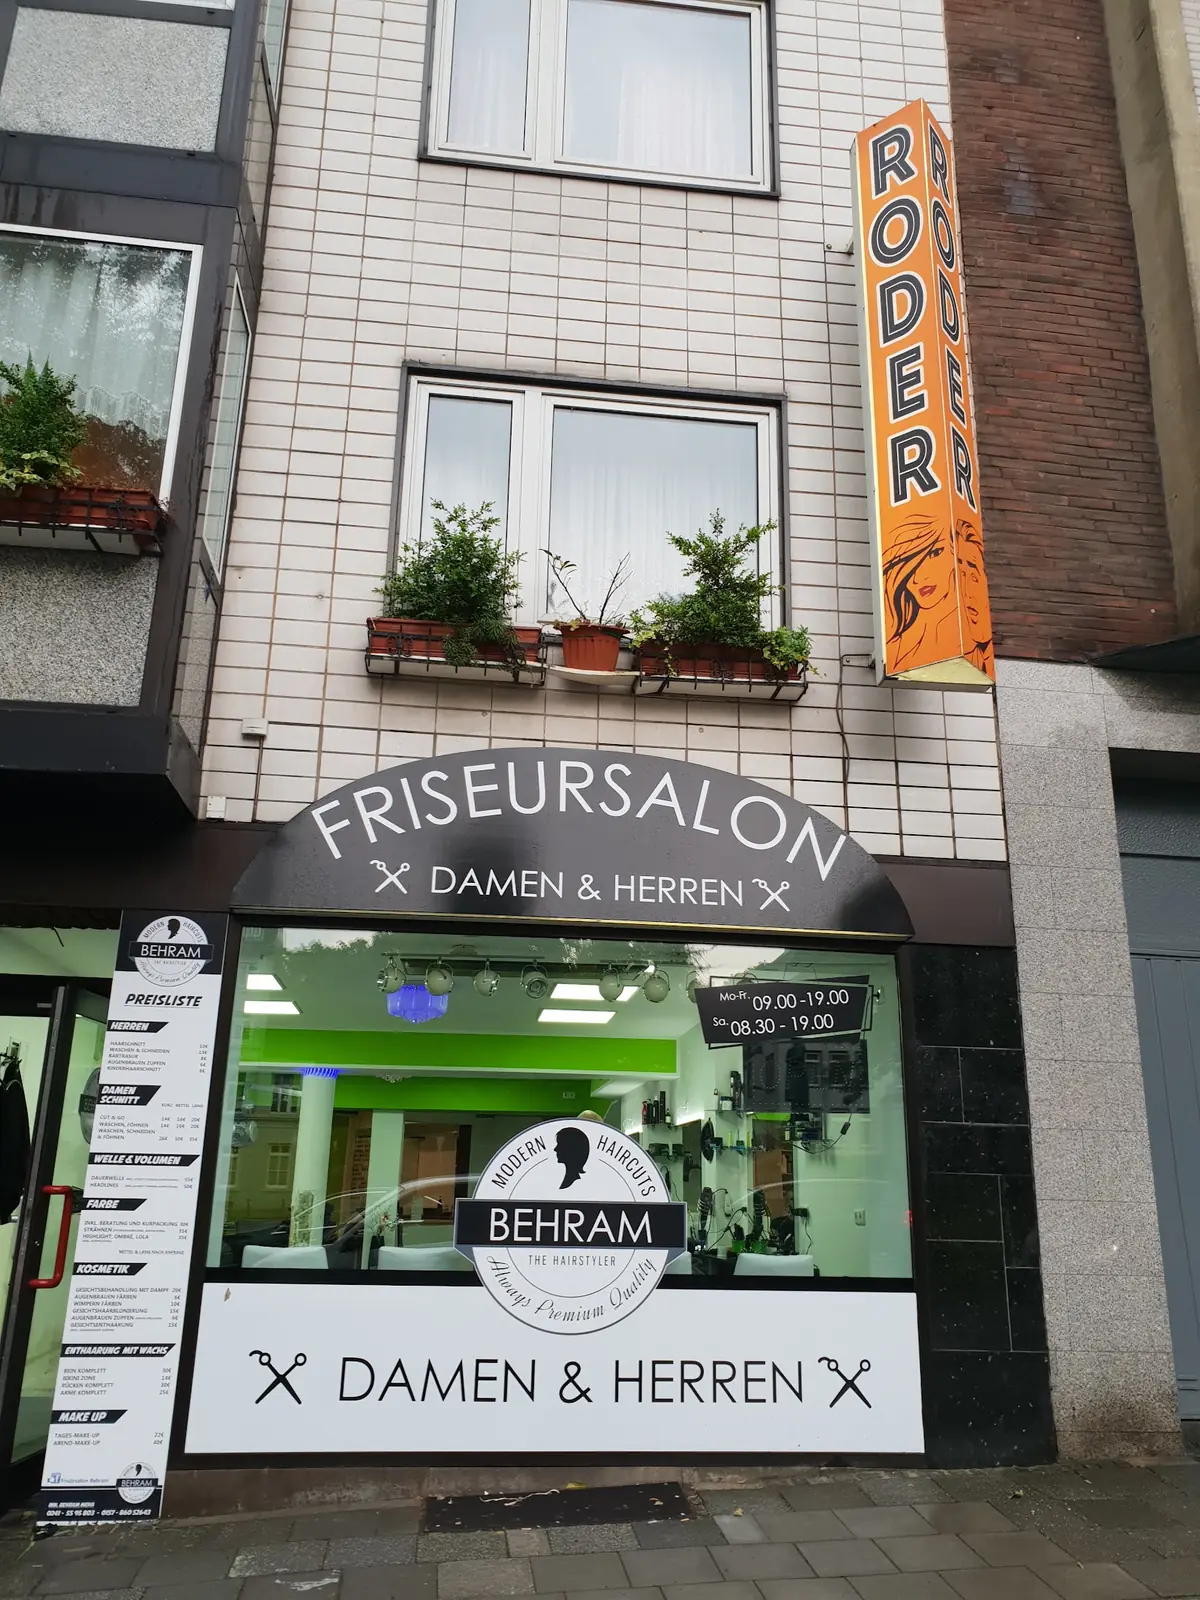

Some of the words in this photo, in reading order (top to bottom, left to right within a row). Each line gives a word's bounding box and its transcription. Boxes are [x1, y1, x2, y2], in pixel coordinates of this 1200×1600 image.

[868, 123, 941, 508] RODER
[927, 119, 978, 513] RODER
[311, 760, 847, 882] FRISEURSALON
[430, 866, 564, 899] DAMEN
[577, 874, 601, 901] &
[614, 875, 744, 906] HERREN
[143, 921, 165, 938] MODERN
[141, 945, 200, 958] BEHRAM
[125, 994, 203, 1006] PREISLISTE
[720, 991, 750, 1001] Mo-Fr.
[753, 994, 796, 1011] 09.00
[110, 1022, 150, 1031] HERREN
[713, 1017, 728, 1027] Sa.
[731, 1019, 775, 1036] 08.30
[791, 1014, 834, 1031] 19.00
[101, 1086, 137, 1095] DAMEN
[100, 1096, 140, 1104] SCHNITT
[94, 1155, 124, 1163] WELLE
[125, 1155, 133, 1163] &
[135, 1155, 181, 1165] VOLUMEN
[492, 1135, 547, 1189] MODERN
[597, 1135, 656, 1197] HAIRCUTS
[86, 1200, 119, 1208] FARBE
[489, 1208, 652, 1244] BEHRAM
[529, 1255, 546, 1265] THE
[553, 1256, 616, 1266] HAIRSTYLER
[76, 1265, 130, 1273] KOSMETIK
[487, 1255, 531, 1307] Always
[535, 1299, 605, 1322] Premium
[609, 1258, 657, 1310] Quality
[65, 1346, 120, 1355] ENTHAARUNG
[122, 1346, 139, 1354] MIT
[140, 1346, 169, 1354] WACHS
[339, 1356, 536, 1402] DAMEN
[559, 1361, 593, 1403] &
[614, 1360, 803, 1403] HERREN
[59, 1412, 90, 1422] MAKE
[91, 1412, 107, 1421] UP
